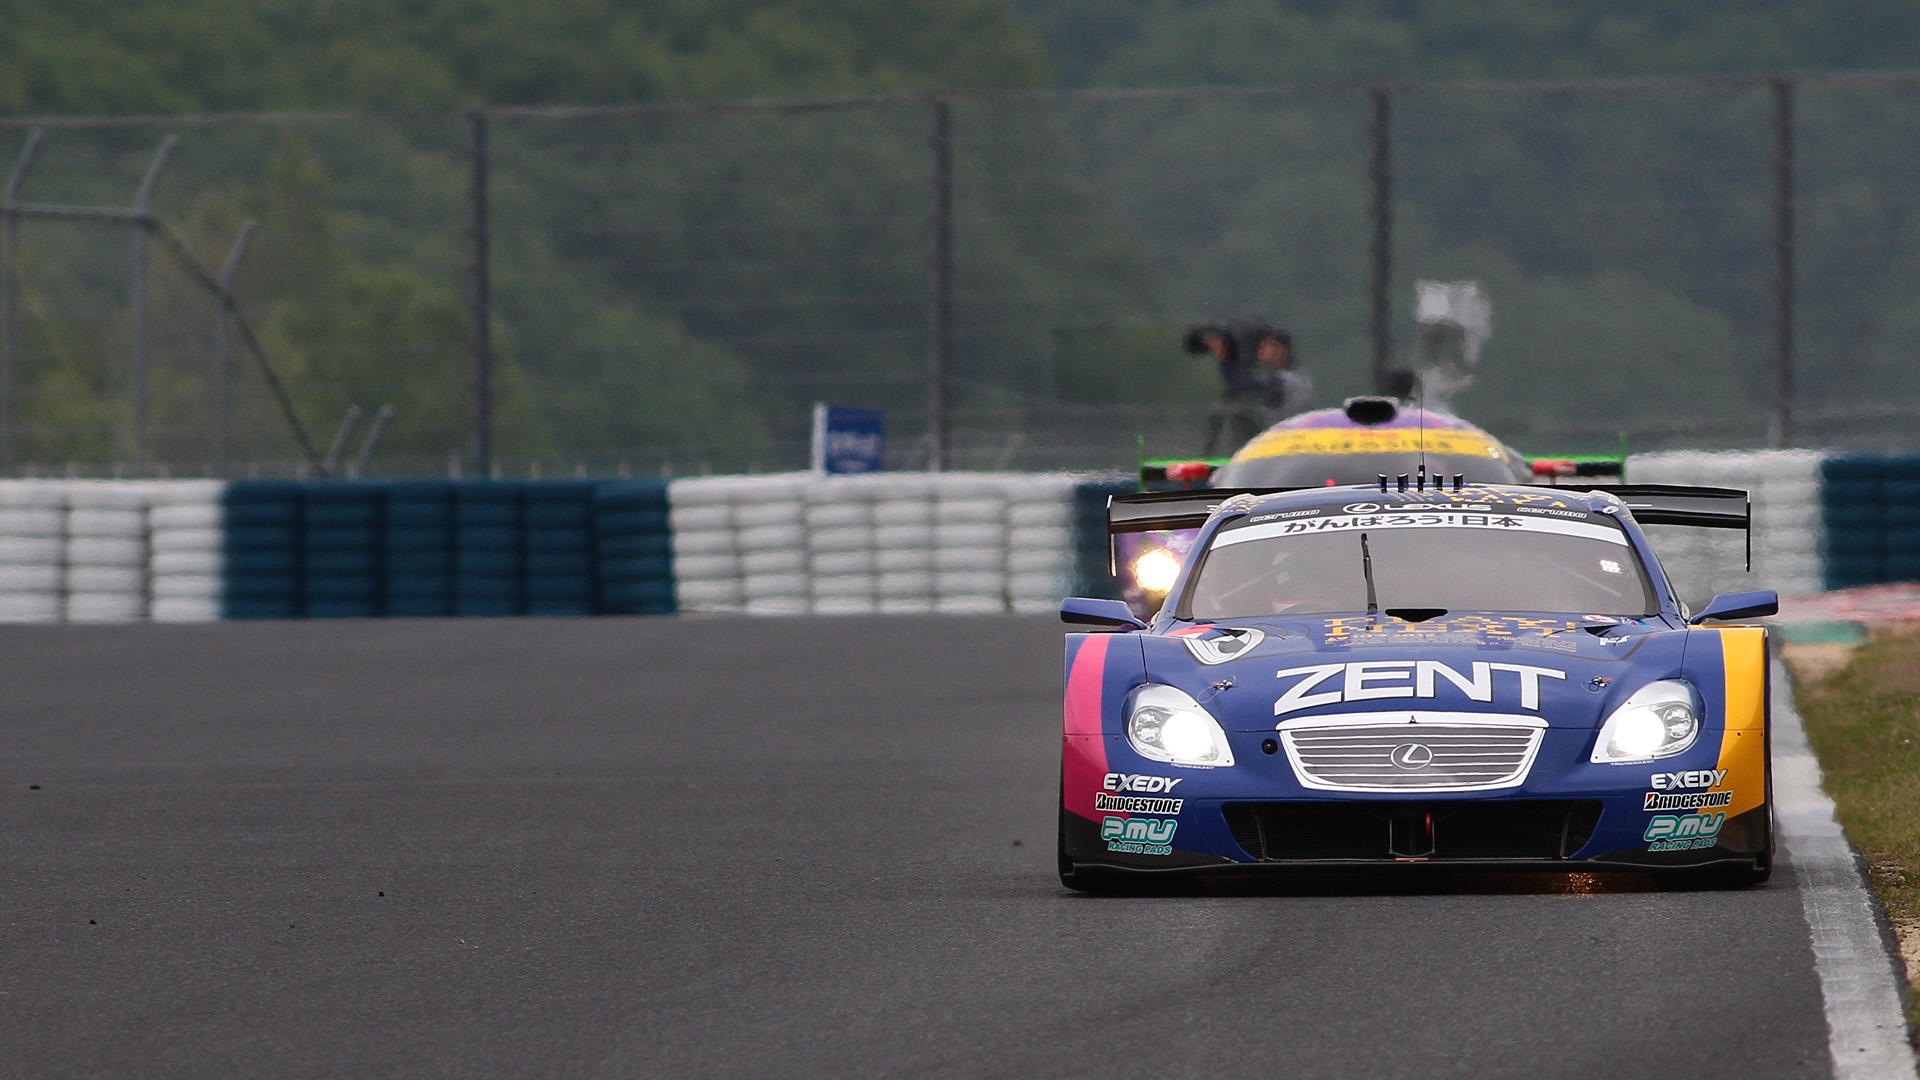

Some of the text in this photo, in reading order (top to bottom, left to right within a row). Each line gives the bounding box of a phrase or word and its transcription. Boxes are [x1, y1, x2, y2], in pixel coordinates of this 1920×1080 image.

[1384, 503, 1492, 512] LEXUS
[1274, 660, 1566, 716] ZENT
[1103, 772, 1183, 793] EXEDY
[1651, 769, 1728, 791] EXEDY
[1096, 792, 1183, 814] BRIDGESTONE
[1644, 791, 1733, 811] BRIDGESTONE
[1108, 842, 1173, 855] RACING PADS
[1648, 837, 1718, 852] RACING PADS
